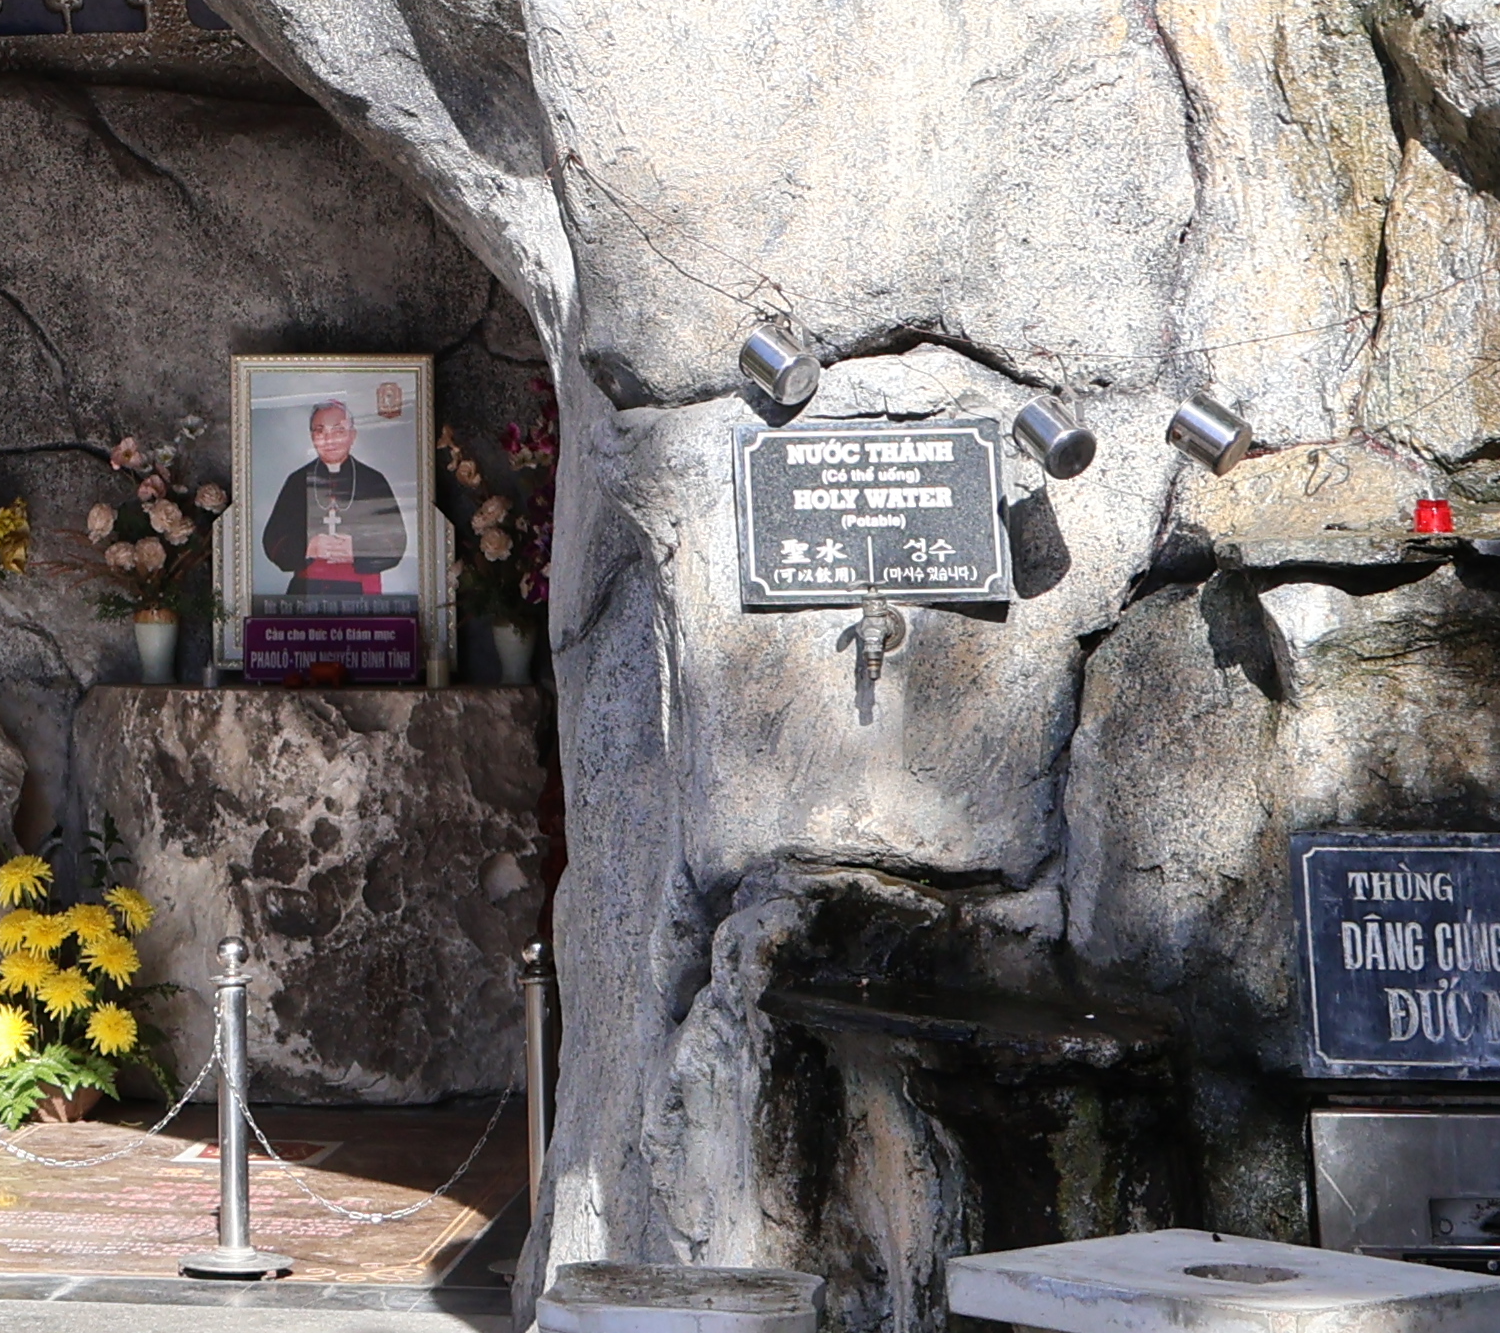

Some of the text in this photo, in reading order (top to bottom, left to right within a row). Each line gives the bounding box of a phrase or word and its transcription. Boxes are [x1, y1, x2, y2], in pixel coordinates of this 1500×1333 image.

[786, 437, 954, 465] NƯỚC THÁNH
[821, 468, 848, 484] (Có
[793, 487, 953, 510] HOLY WATER
[841, 513, 906, 530] (Potable)
[780, 538, 847, 564] 聖水
[903, 538, 956, 562] 성수
[1347, 862, 1454, 903] THÙNG
[1341, 913, 1425, 971] DÂNG
[1384, 976, 1475, 1044] ĐỨC
